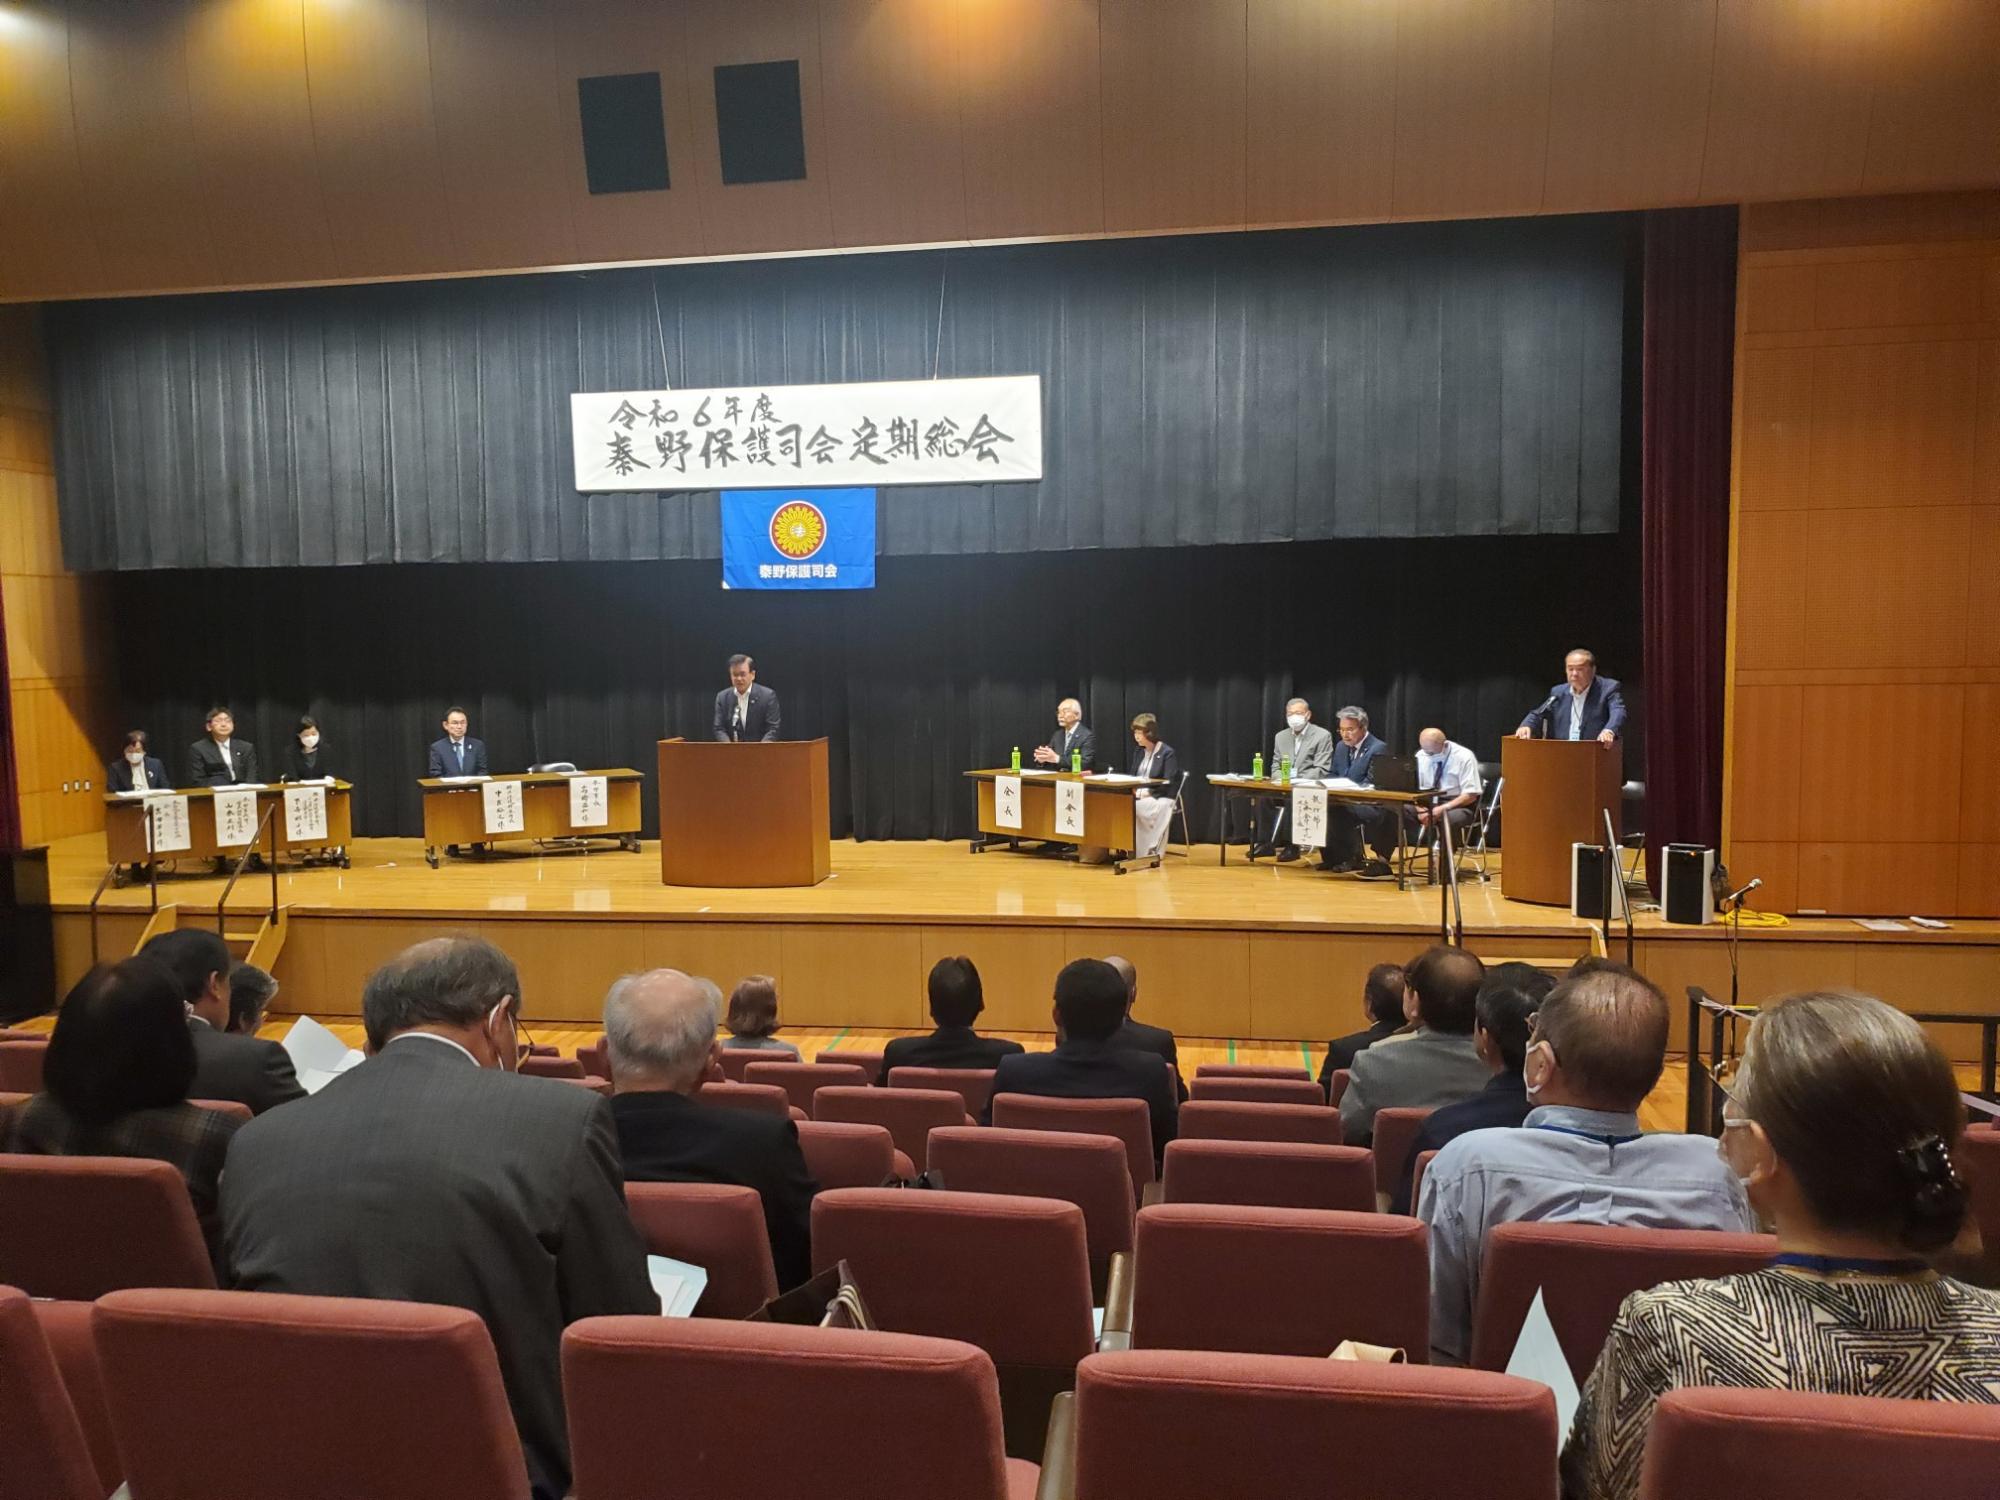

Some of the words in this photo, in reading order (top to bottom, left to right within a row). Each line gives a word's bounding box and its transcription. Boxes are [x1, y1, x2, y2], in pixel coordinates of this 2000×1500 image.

[607, 392, 783, 429] 令和6年度
[604, 413, 1014, 476] 秦野保護司会定期総会
[759, 563, 838, 579] 秦野保護司会
